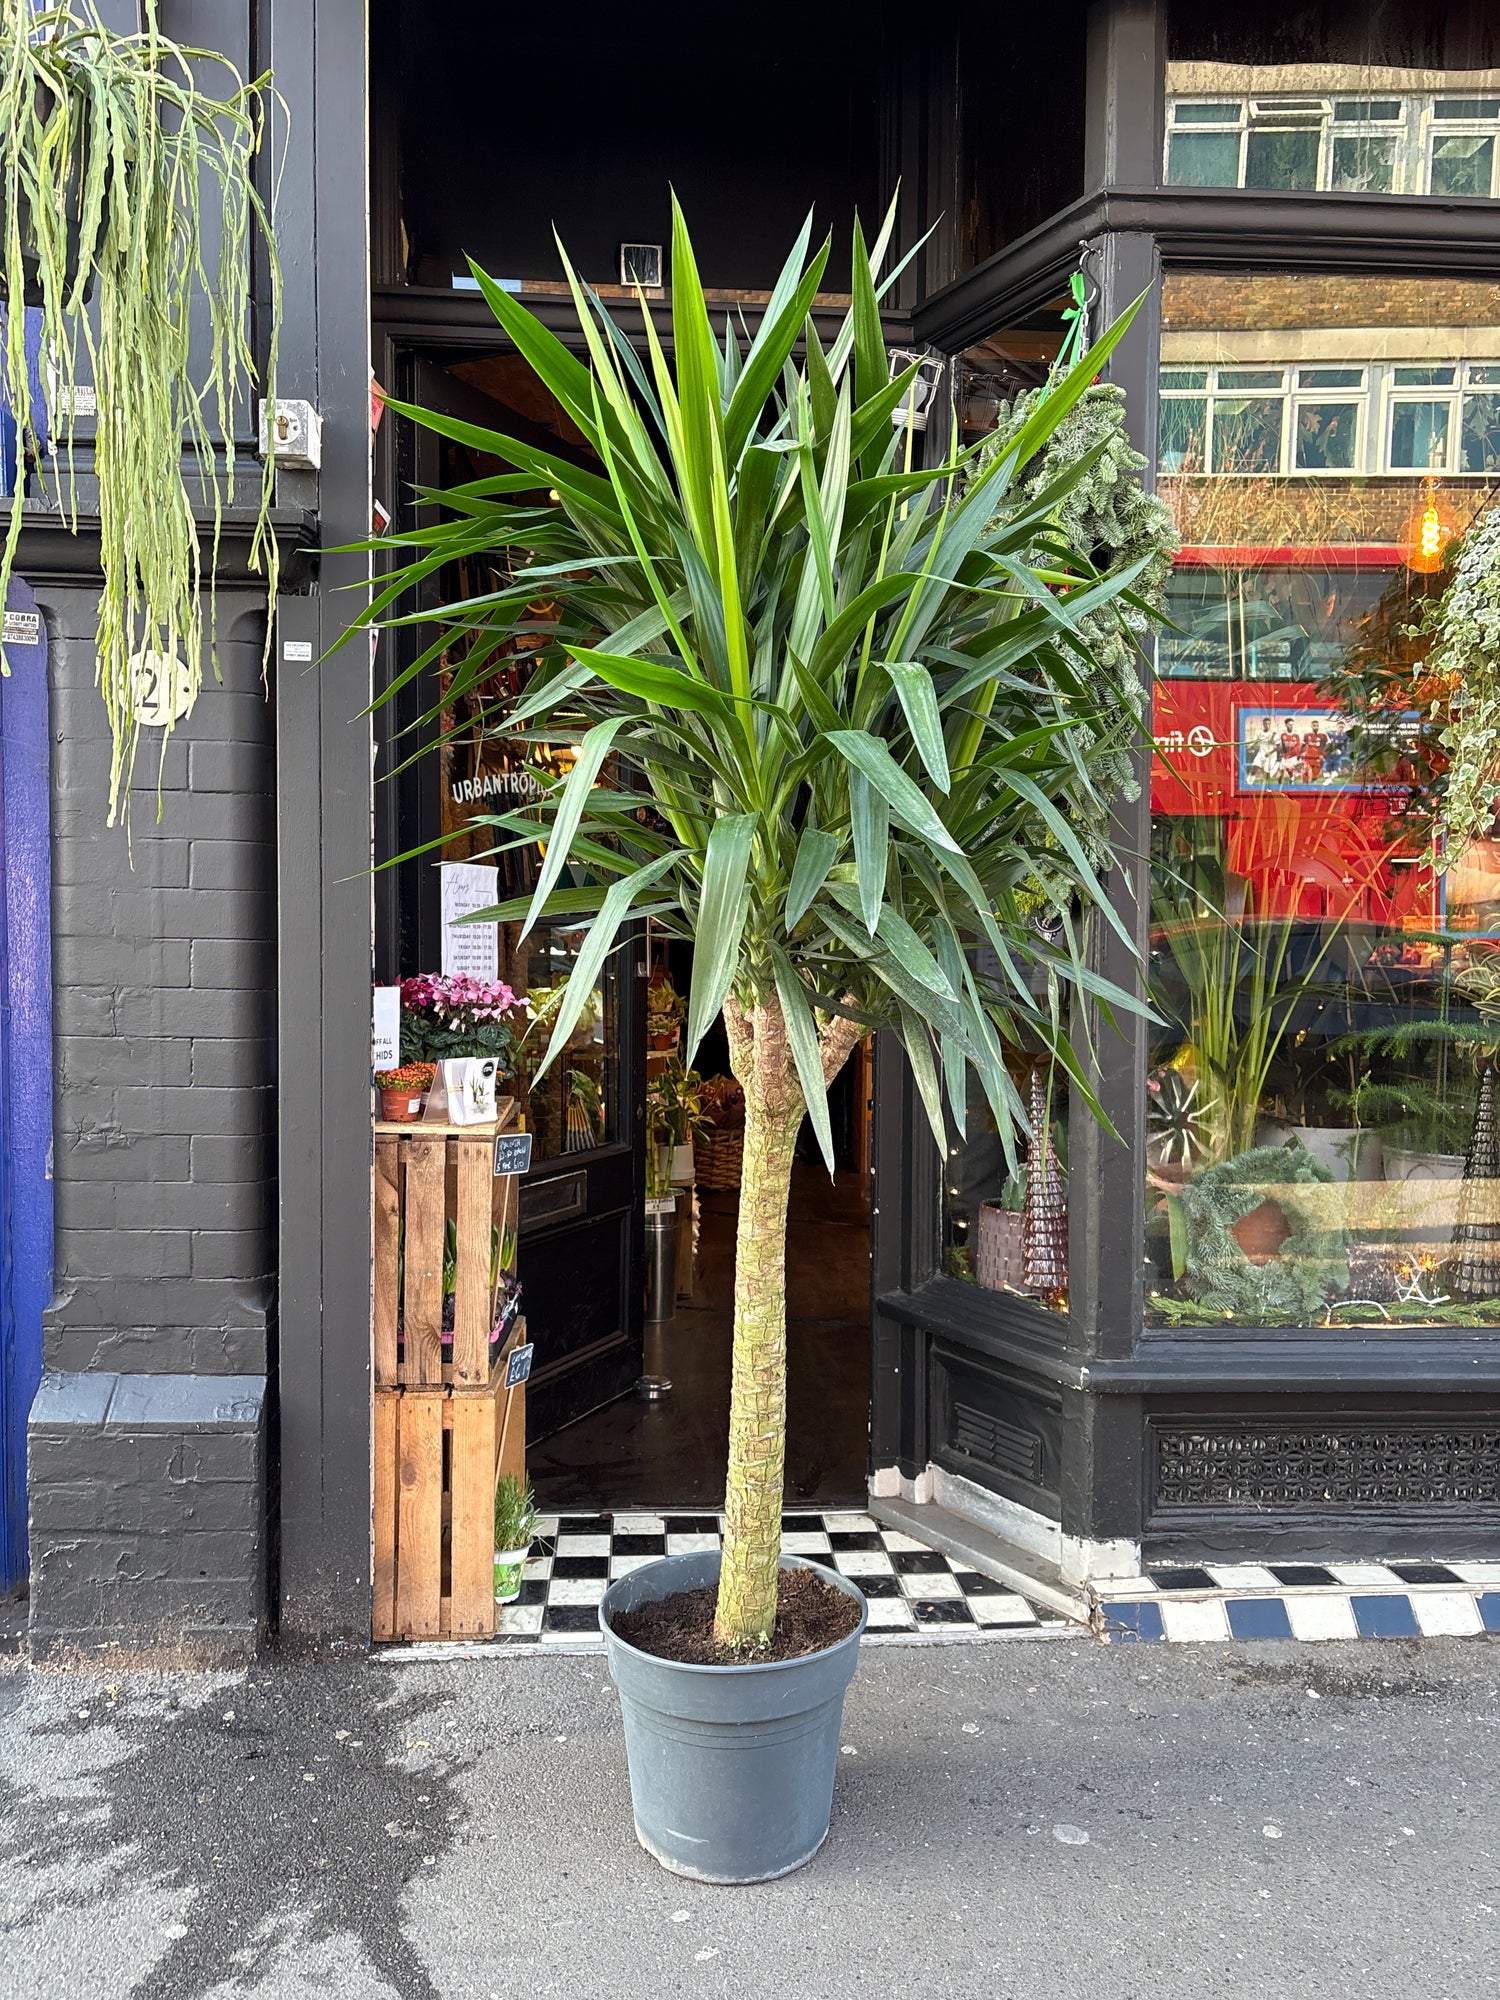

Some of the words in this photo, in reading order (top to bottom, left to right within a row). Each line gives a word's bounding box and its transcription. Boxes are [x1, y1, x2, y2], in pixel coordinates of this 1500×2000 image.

[9, 614, 37, 623] COBRA
[502, 1161, 511, 1170] FOR
[513, 1158, 524, 1169] £10
